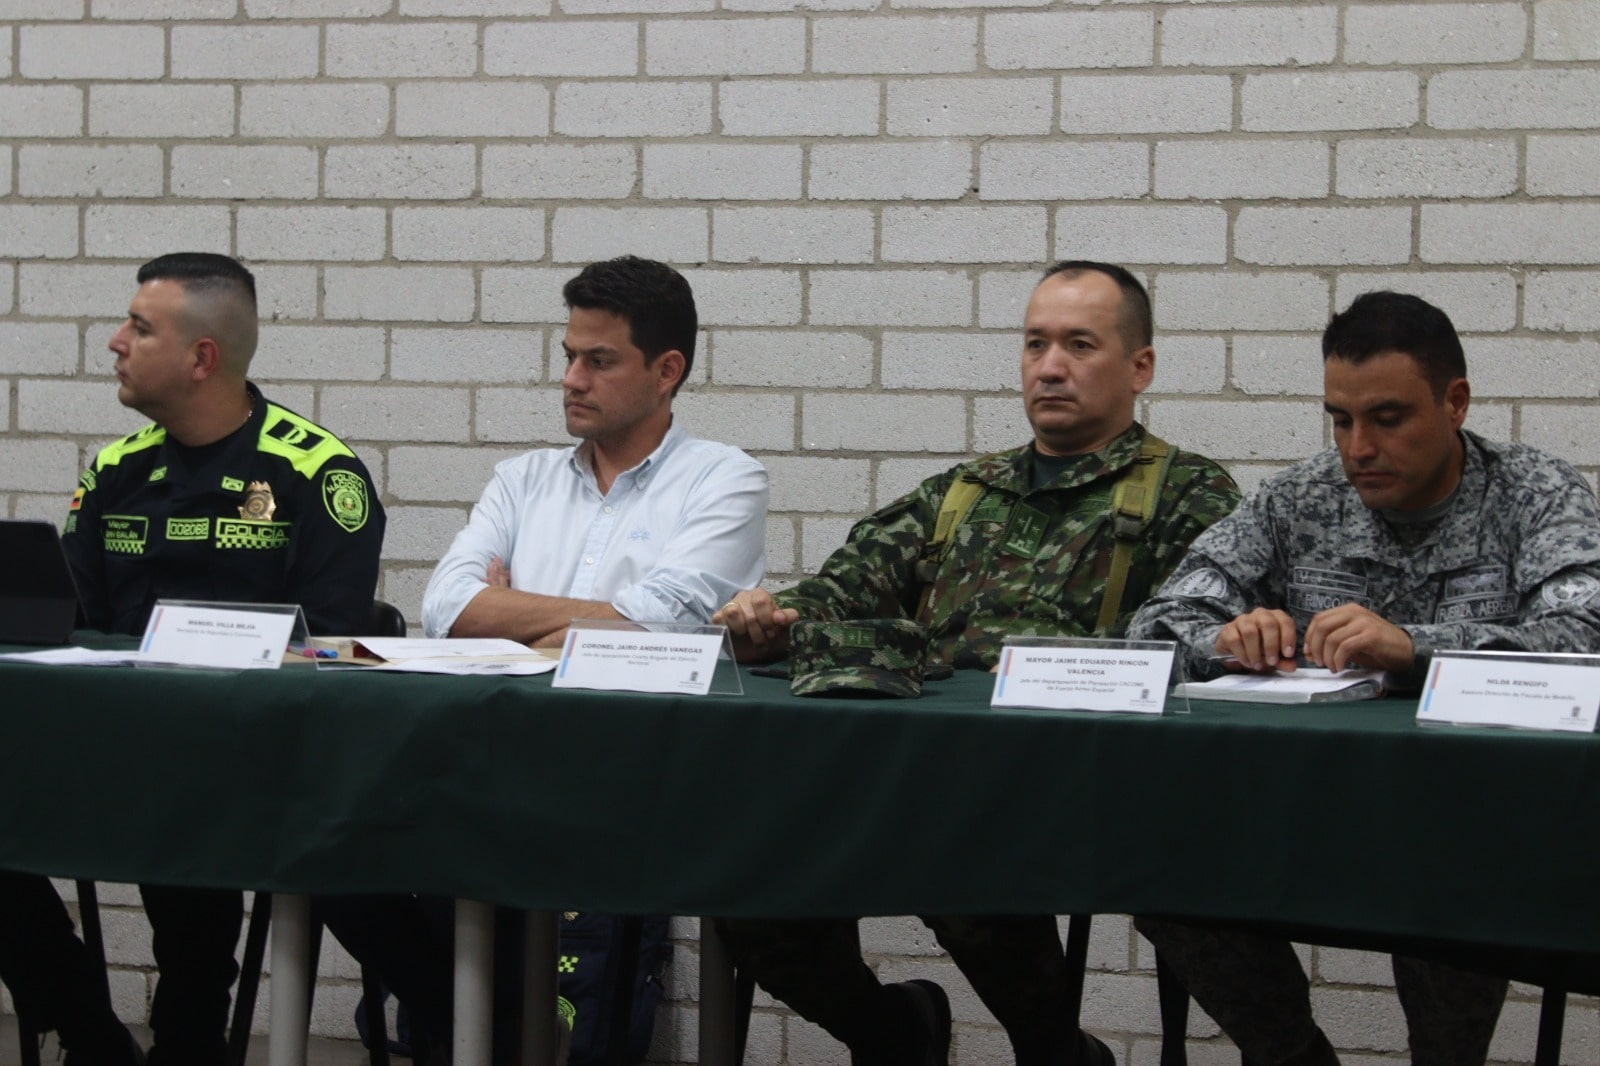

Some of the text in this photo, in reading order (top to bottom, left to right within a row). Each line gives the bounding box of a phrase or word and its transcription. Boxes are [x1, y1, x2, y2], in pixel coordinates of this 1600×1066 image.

[224, 524, 286, 539] POLICÍA
[1439, 603, 1474, 620] FUERZA
[1067, 668, 1105, 676] VALENCIA
